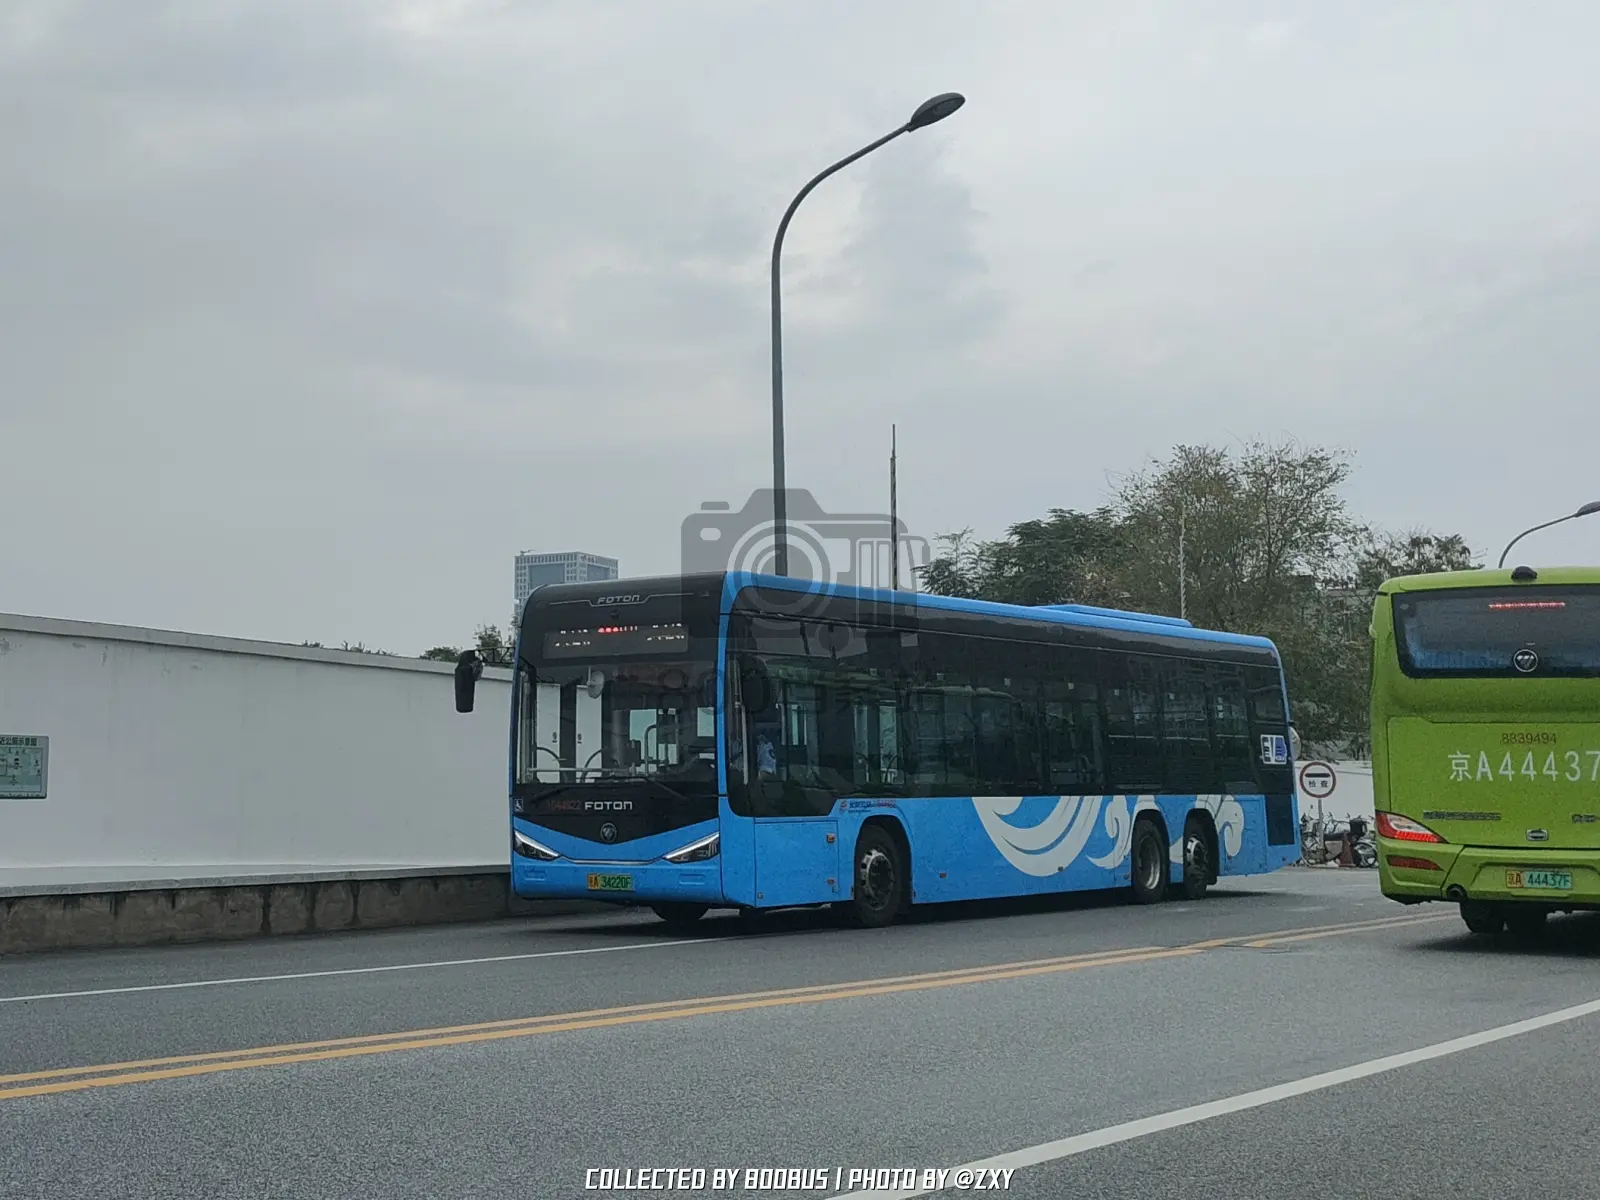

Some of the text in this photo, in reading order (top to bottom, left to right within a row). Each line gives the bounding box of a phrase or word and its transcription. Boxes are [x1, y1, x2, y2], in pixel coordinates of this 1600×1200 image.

[597, 595, 640, 604] FOTON
[1501, 732, 1557, 744] 8839494
[1447, 750, 1600, 782] 京A44437
[585, 801, 633, 810] FOTON
